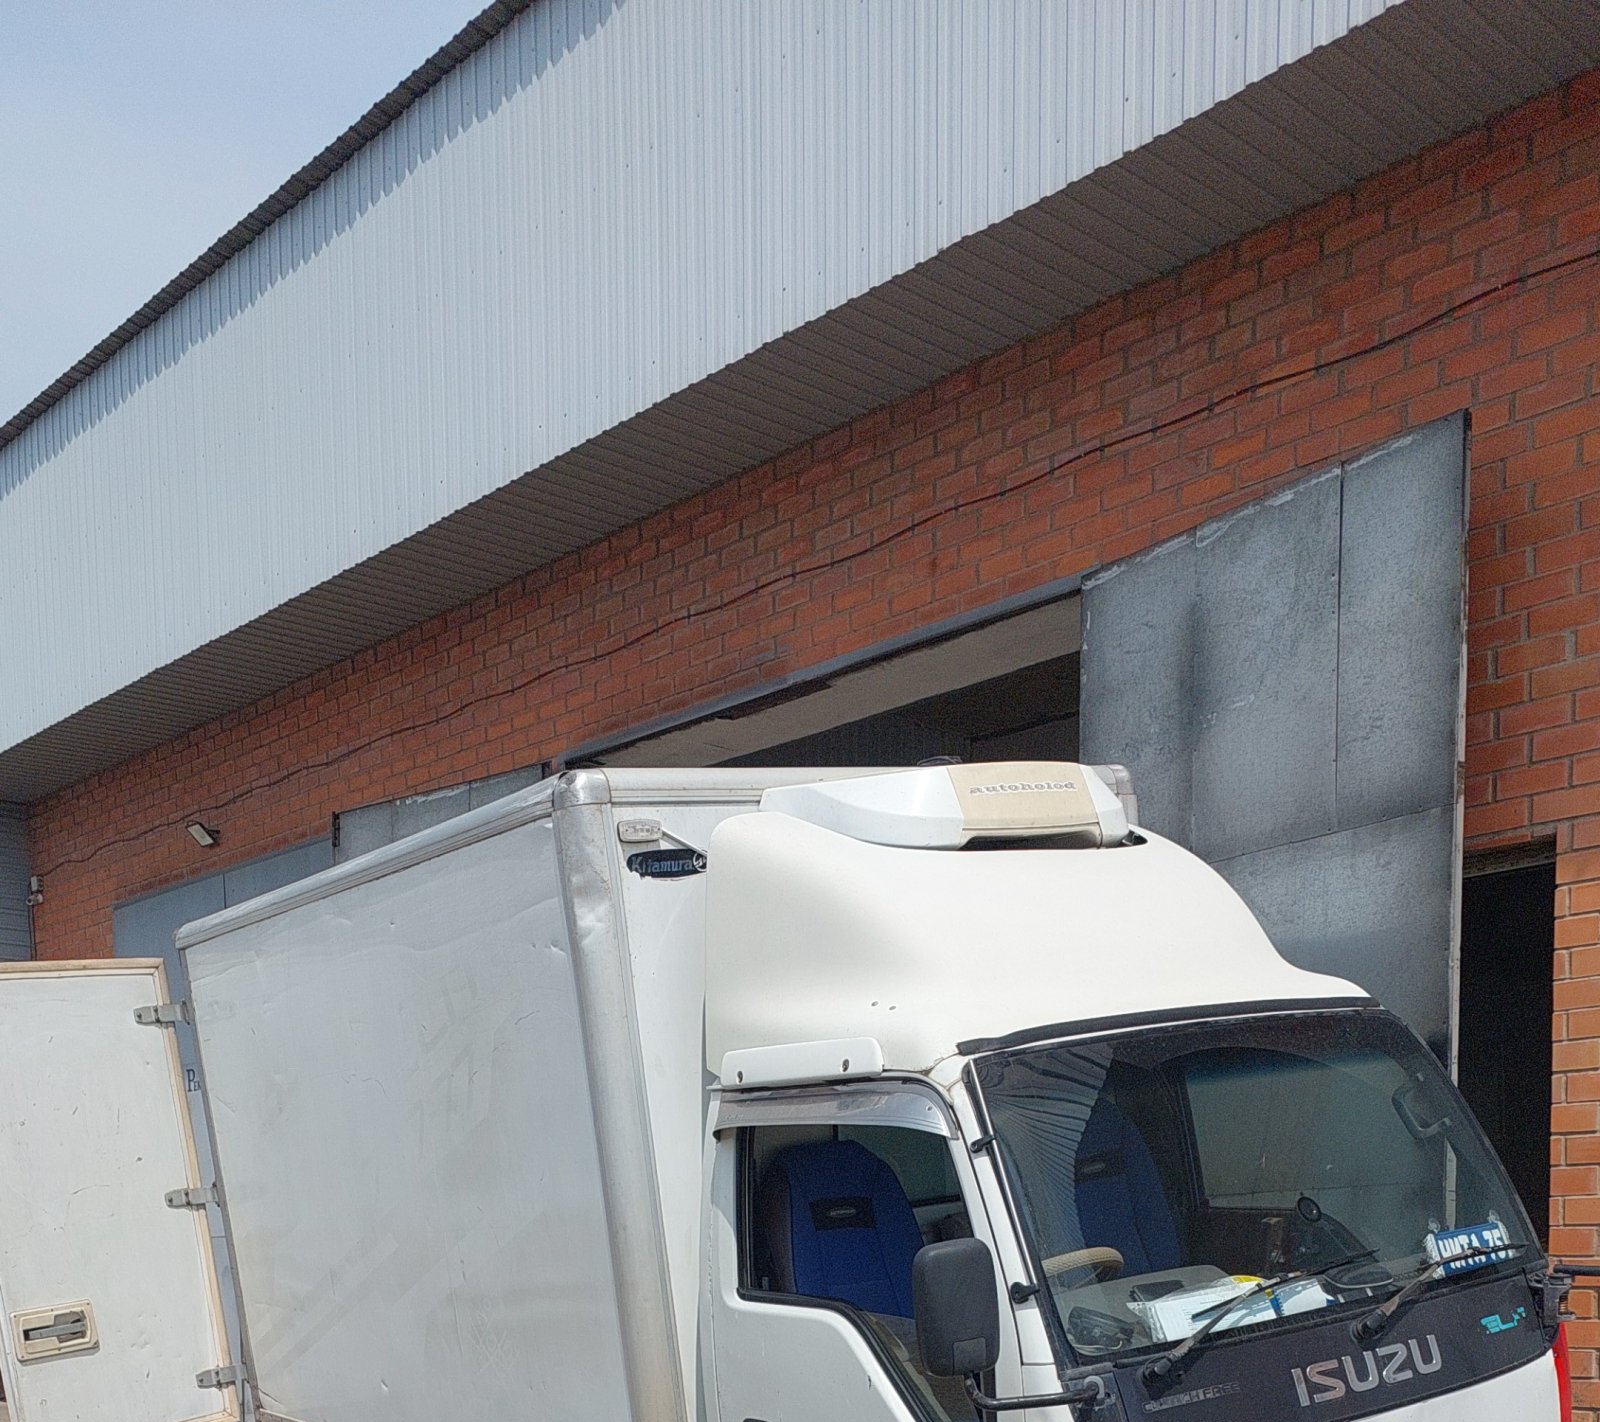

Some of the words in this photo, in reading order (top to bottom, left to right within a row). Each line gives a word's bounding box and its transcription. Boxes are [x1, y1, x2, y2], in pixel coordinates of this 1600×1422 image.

[968, 780, 1077, 794] autoholod
[630, 855, 694, 874] Kitamura
[1291, 1334, 1442, 1407] ISUZU
